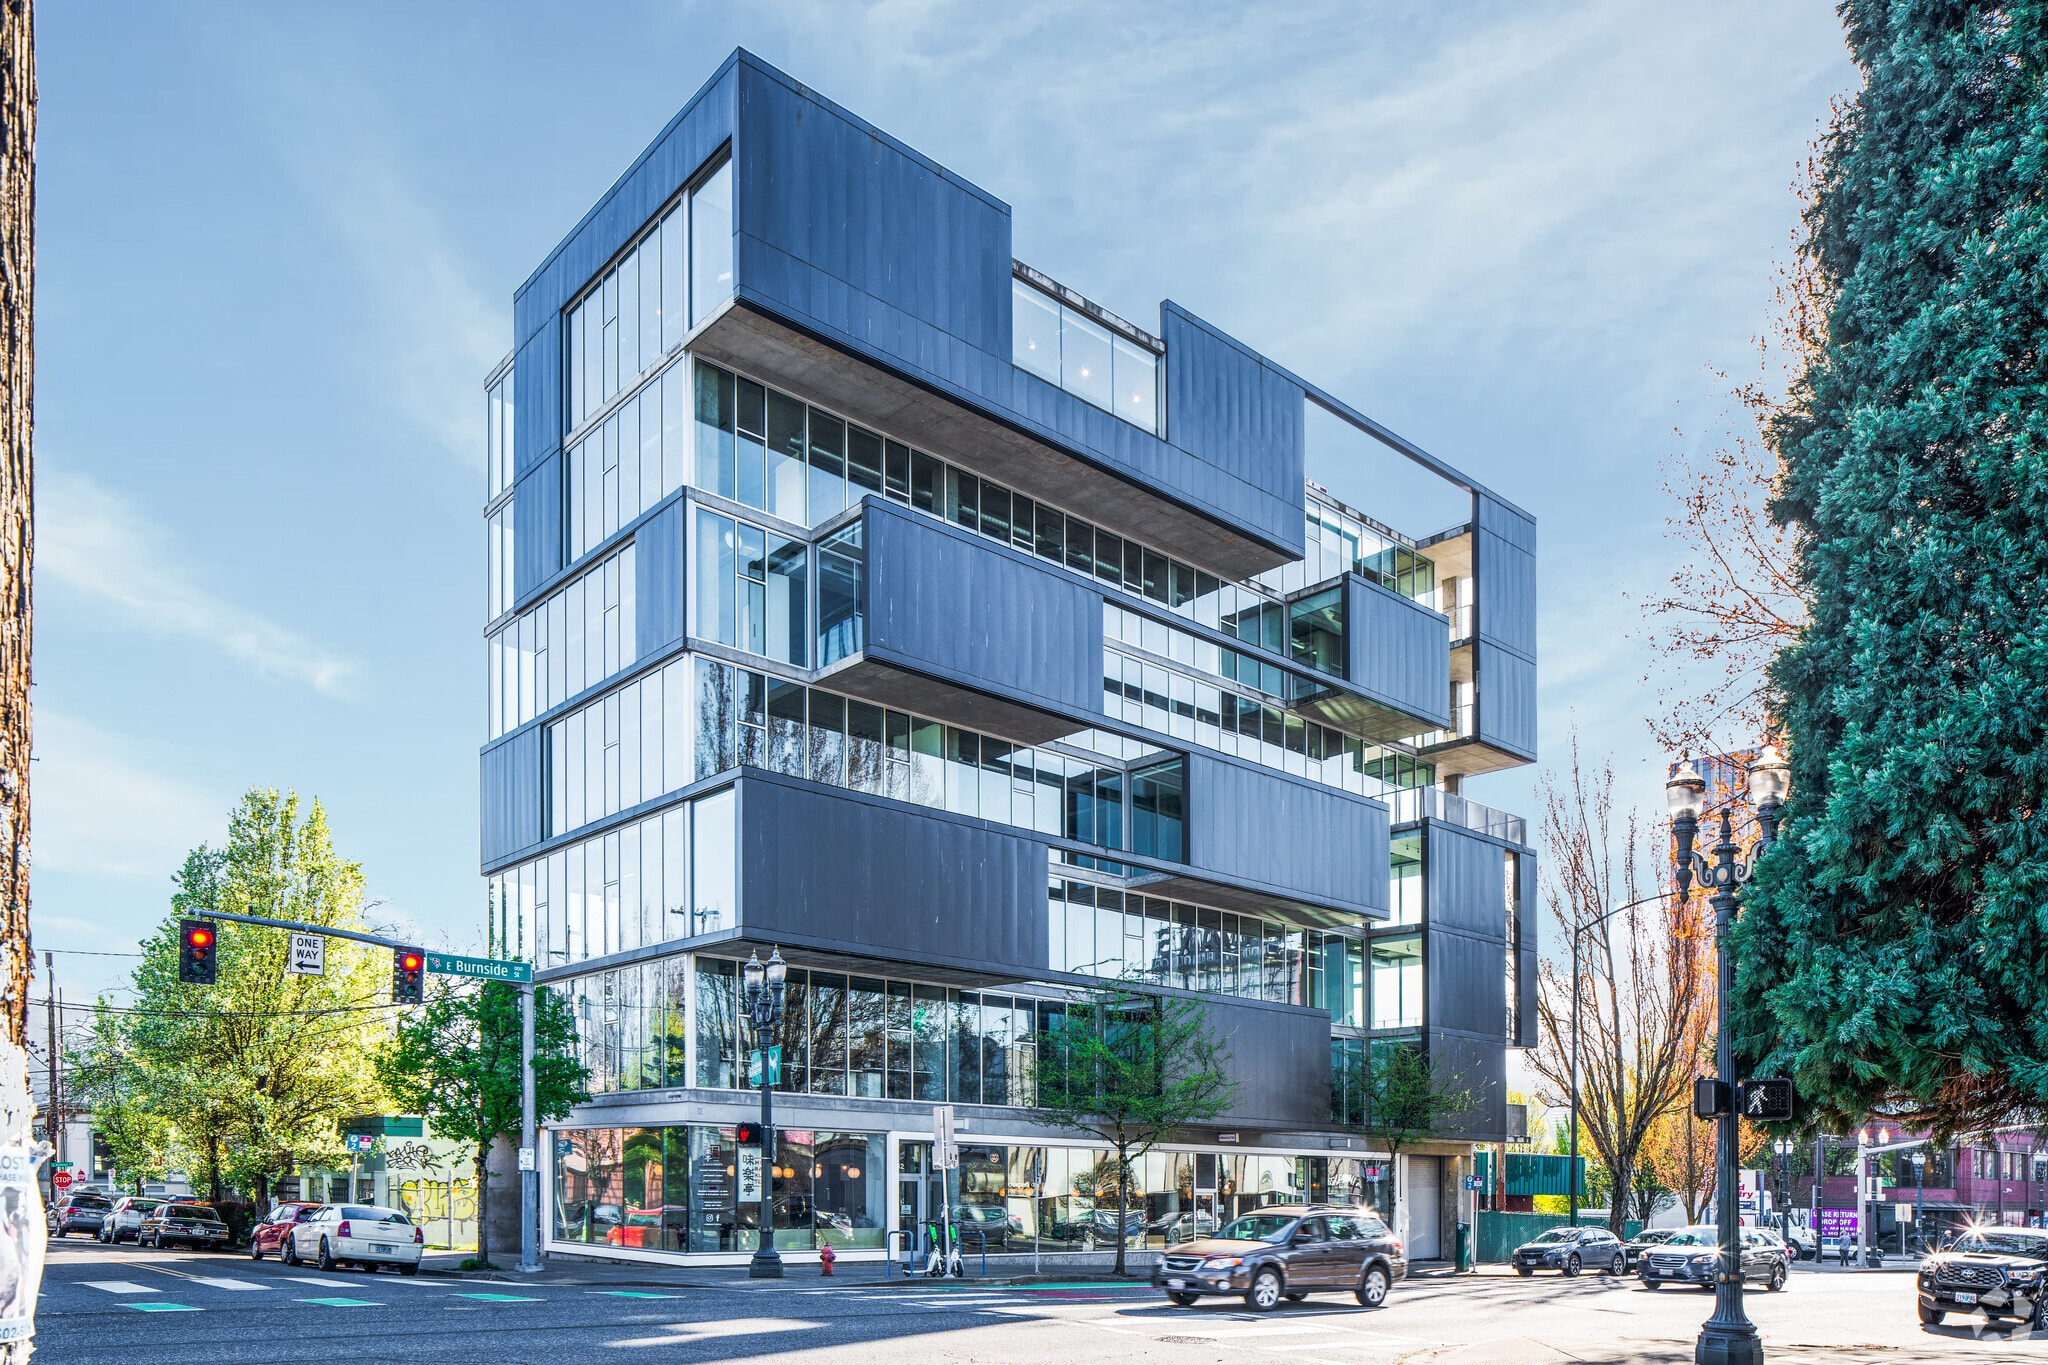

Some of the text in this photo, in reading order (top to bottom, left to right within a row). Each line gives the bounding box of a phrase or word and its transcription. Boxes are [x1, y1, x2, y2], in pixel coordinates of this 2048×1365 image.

[296, 937, 319, 949] ONE
[296, 949, 319, 960] WAY
[446, 960, 508, 977] E Burnside
[0, 1155, 24, 1170] OST
[54, 1176, 71, 1184] STOP
[742, 1153, 755, 1197] 味楽亭
